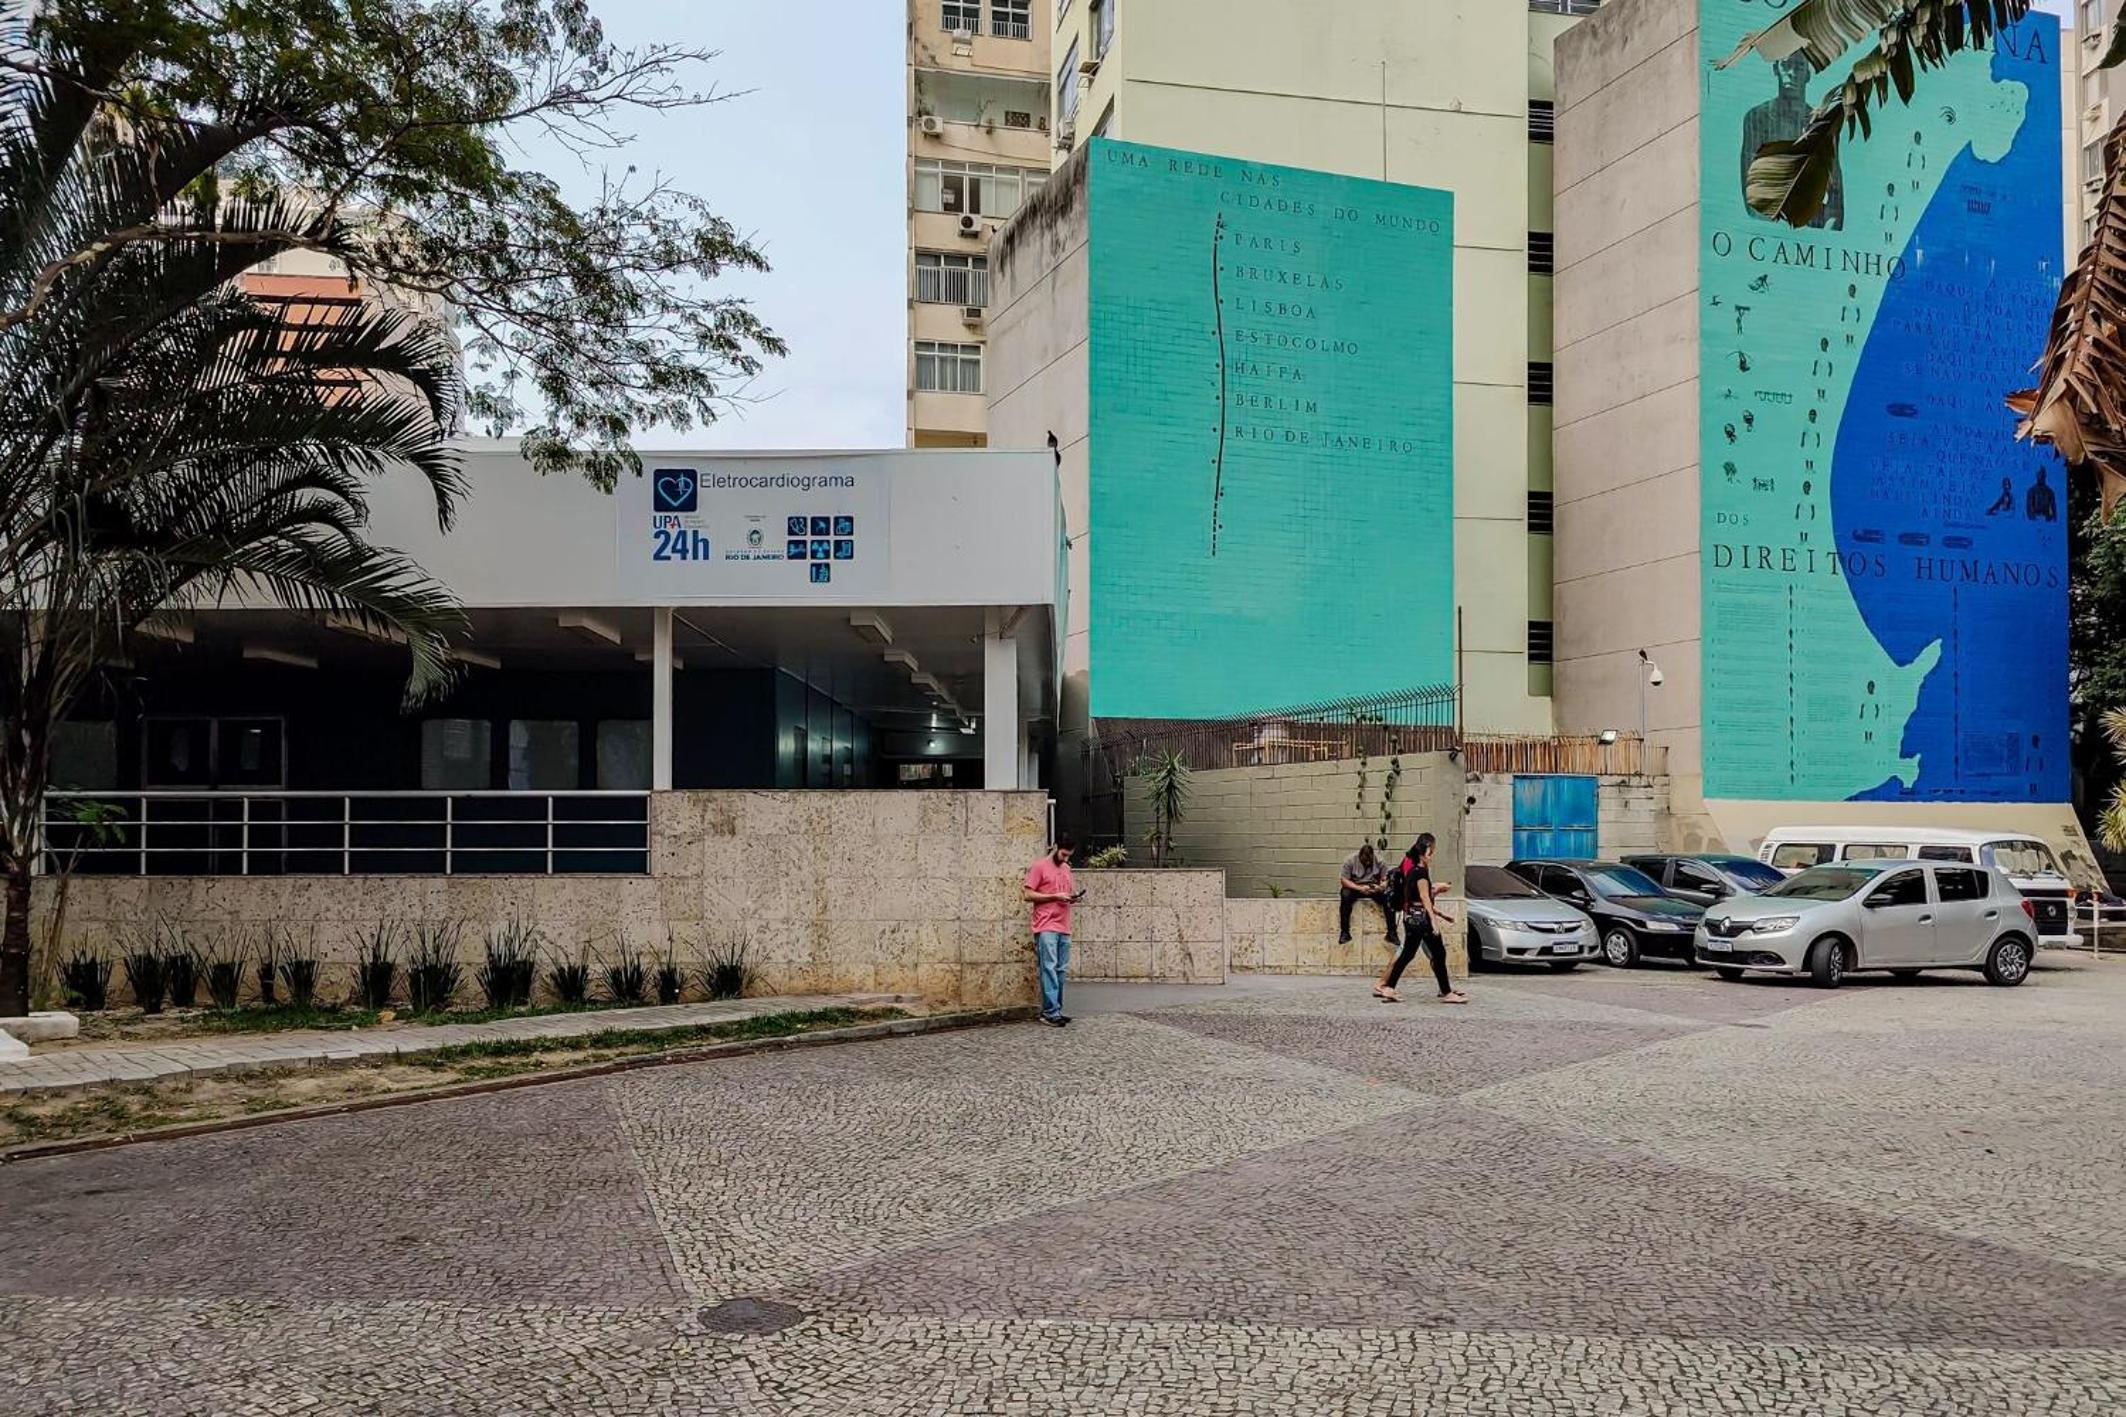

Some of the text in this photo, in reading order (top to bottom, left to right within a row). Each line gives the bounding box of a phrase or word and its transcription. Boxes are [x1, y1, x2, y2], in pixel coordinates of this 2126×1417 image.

[1106, 149, 1282, 187] UMA REDE NAS
[1220, 191, 1441, 235] CIDADES DO MUNDO
[1235, 234, 1302, 255] PARIS
[1711, 231, 1906, 281] O CAMINHO
[1235, 265, 1344, 290] BRUXELAS
[1235, 297, 1317, 319] LISBOA
[1235, 330, 1359, 356] ESTOCOLMO
[1234, 361, 1303, 381] HAIFA
[1235, 393, 1318, 413] BERLIM
[1235, 426, 1413, 455] RIO DE JANEIRO
[700, 471, 855, 491] Eletrocardiograma
[652, 515, 682, 530] UPA
[1716, 511, 1750, 526] DOS
[652, 529, 710, 561] 24h
[1713, 544, 2060, 589] DIREITOS HUMANOS
